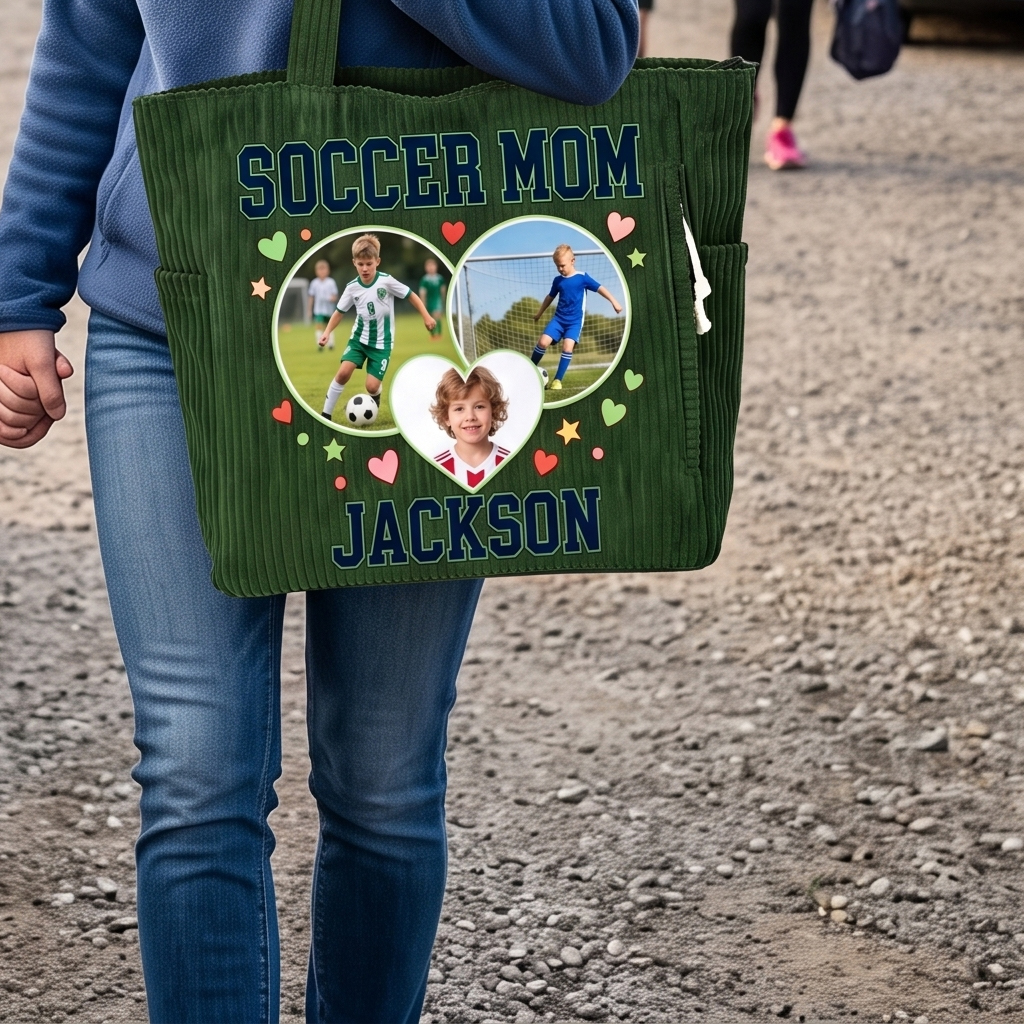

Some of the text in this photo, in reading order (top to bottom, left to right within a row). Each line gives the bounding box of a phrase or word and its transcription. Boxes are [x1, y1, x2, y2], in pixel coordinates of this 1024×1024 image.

[237, 123, 645, 220] SOCCER MOM
[331, 486, 602, 569] JACKSON
